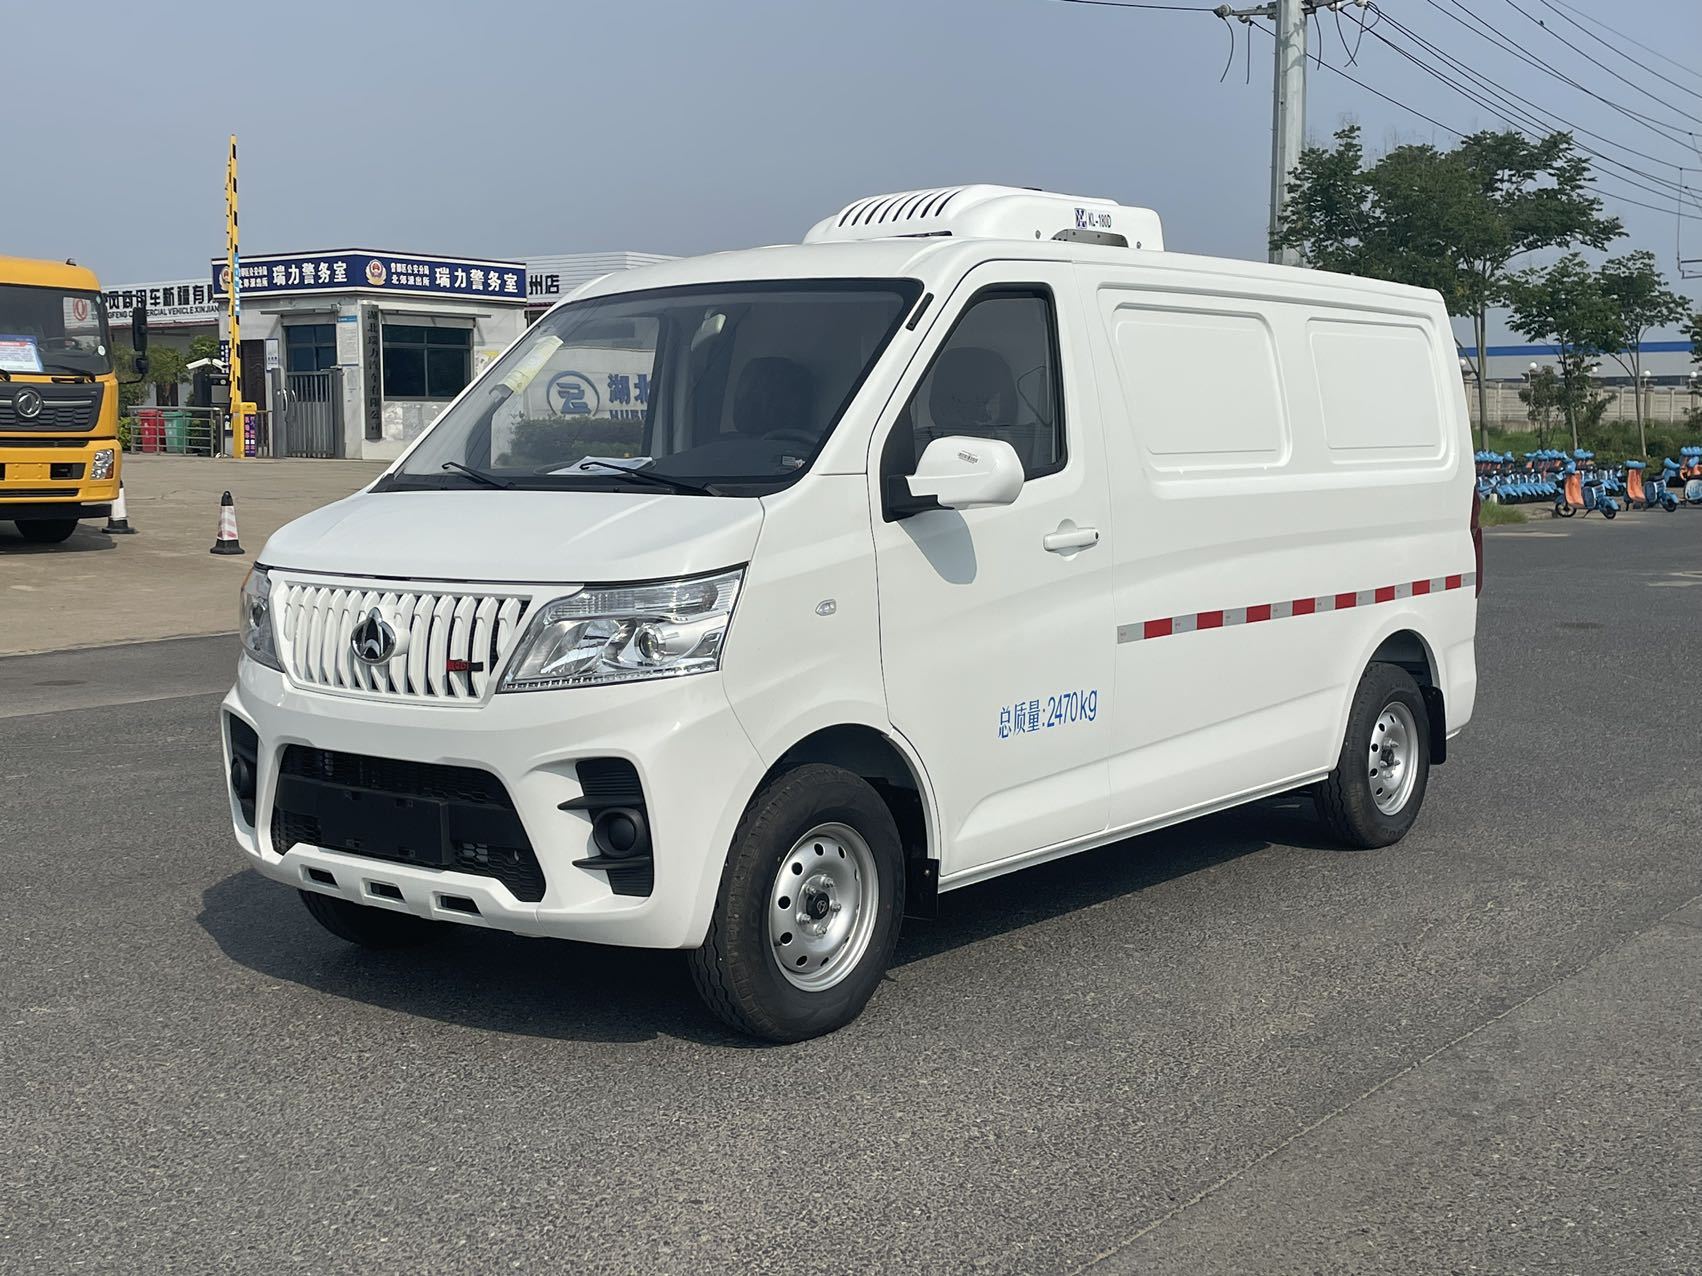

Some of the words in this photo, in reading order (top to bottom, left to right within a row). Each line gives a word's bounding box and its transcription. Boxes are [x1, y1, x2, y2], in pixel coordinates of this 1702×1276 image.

[272, 260, 348, 286] 瑞力警务室
[434, 265, 519, 294] 瑞力警务室
[529, 273, 560, 295] 州店
[106, 284, 213, 310] 风商用车新疆有
[168, 306, 194, 316] VEHICLE
[997, 688, 1099, 740] 总质量:2470kg
